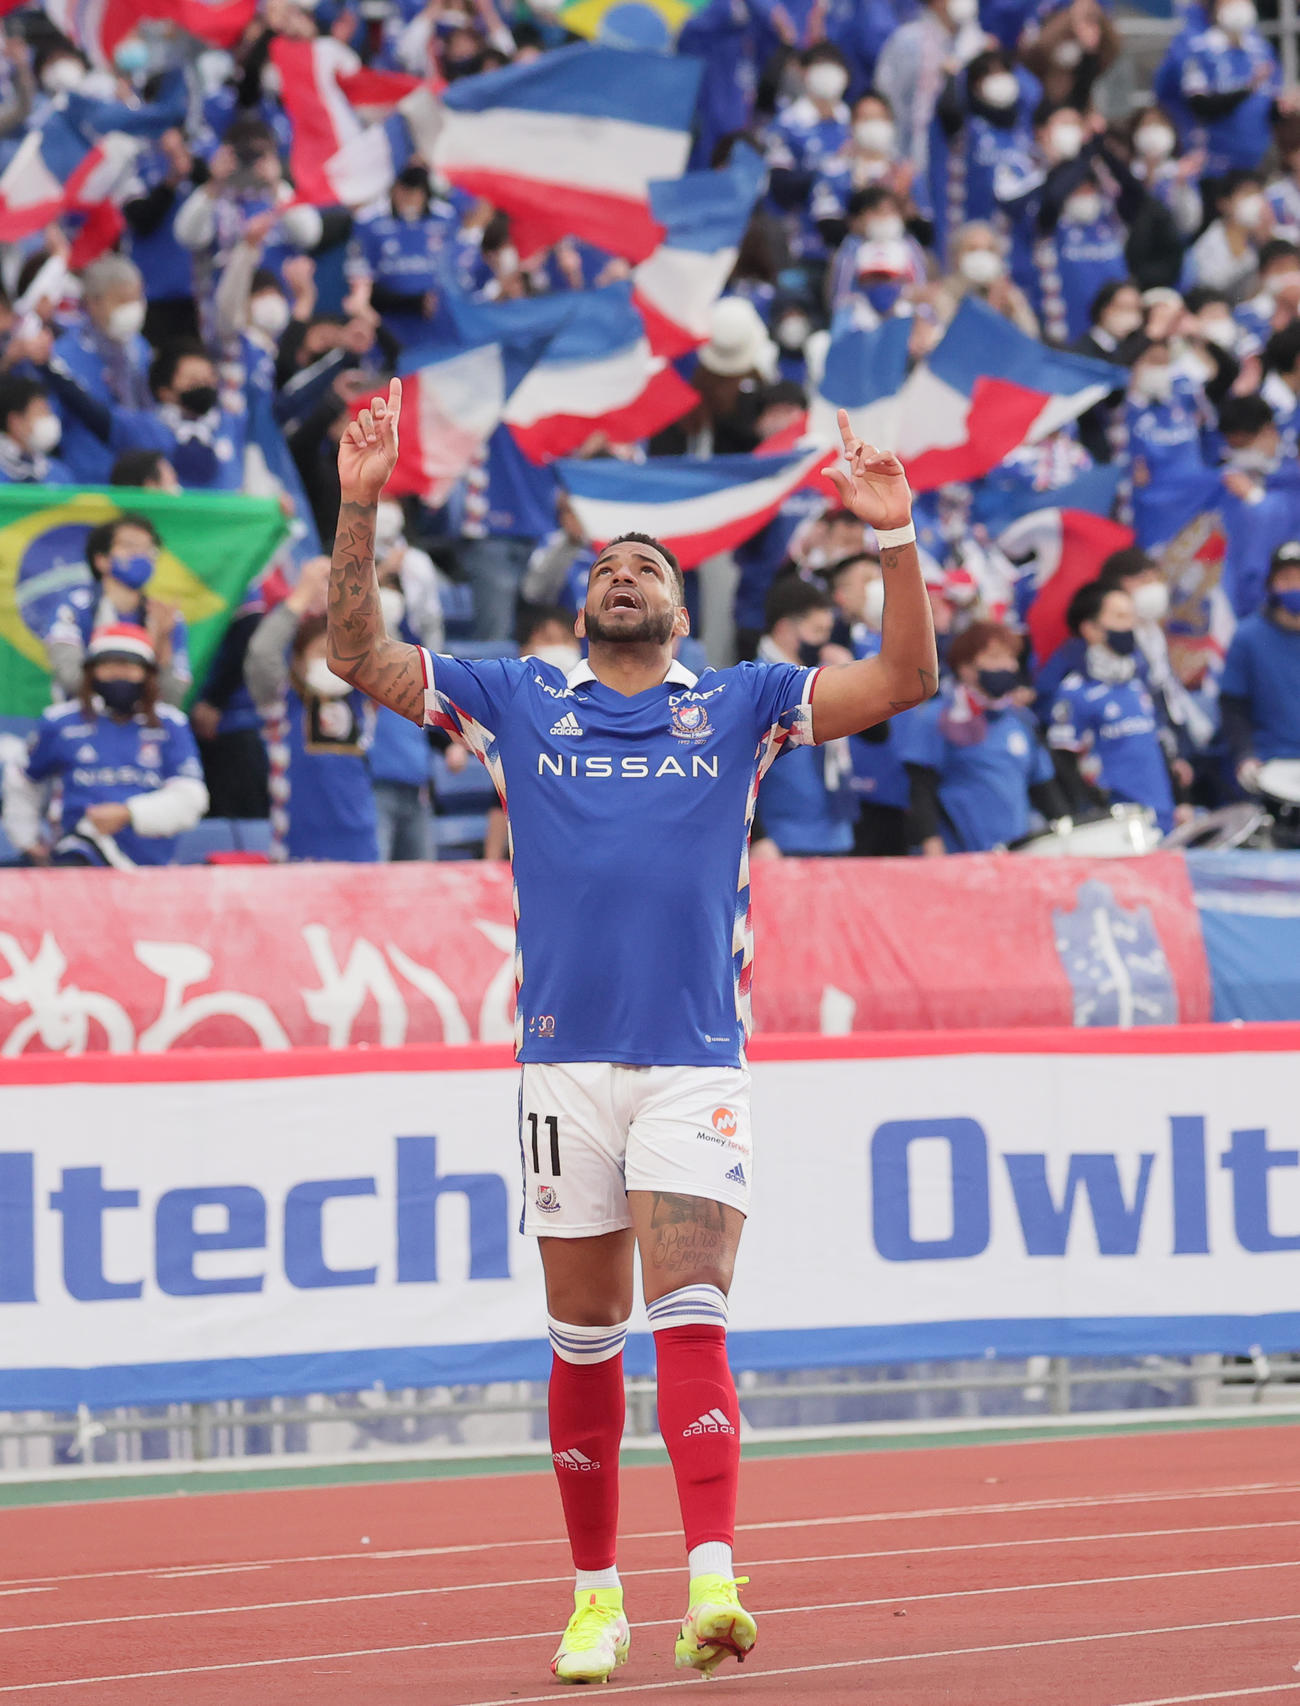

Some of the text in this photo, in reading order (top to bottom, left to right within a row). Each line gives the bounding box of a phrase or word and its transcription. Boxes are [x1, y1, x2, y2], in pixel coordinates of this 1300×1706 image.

[668, 684, 726, 706] DRAFT
[549, 725, 583, 736] adidas
[538, 753, 719, 778] NISSAN
[527, 1112, 561, 1177] 11
[696, 1131, 726, 1147] Money
[870, 1114, 1300, 1263] Owlt
[682, 1423, 735, 1437] adidas
